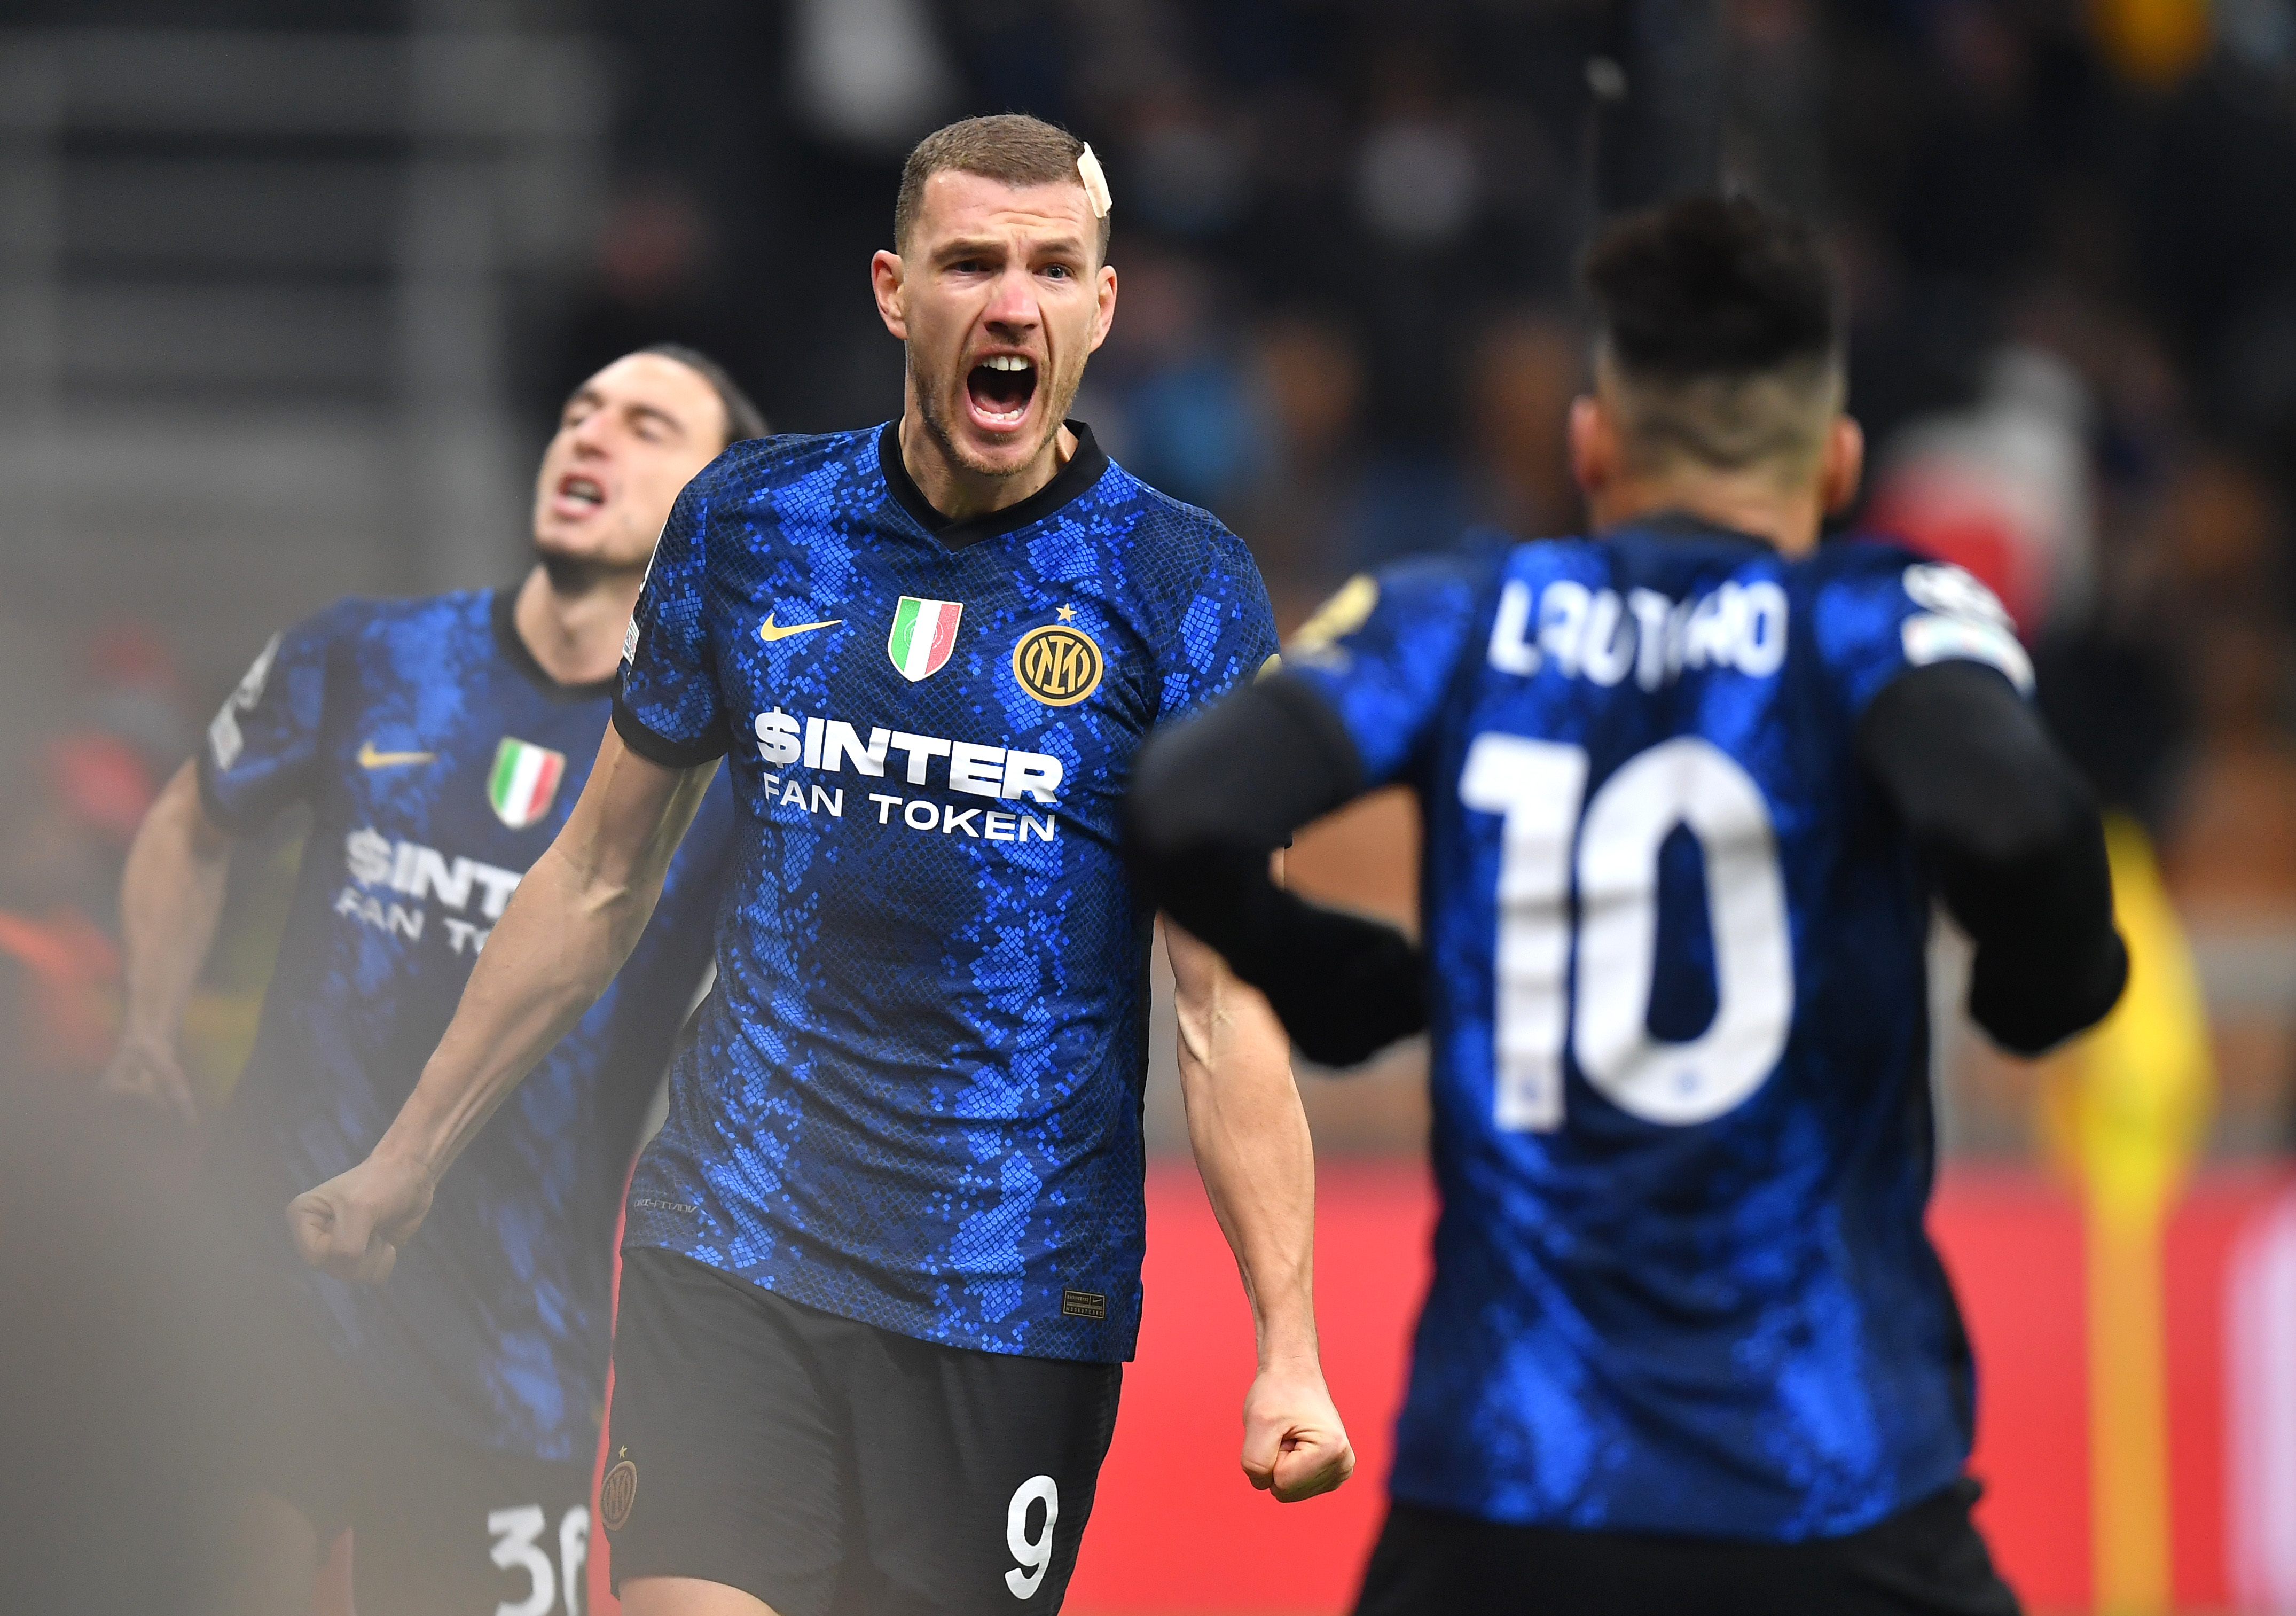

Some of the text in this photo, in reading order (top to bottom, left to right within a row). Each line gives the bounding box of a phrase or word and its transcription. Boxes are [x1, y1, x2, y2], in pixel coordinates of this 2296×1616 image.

[755, 706, 1064, 803] $INTER
[763, 772, 1055, 842] FAN TOKEN
[336, 887, 425, 941] FAN
[346, 826, 523, 920] $INT
[1459, 732, 1795, 1133] 10
[1005, 1474, 1059, 1599] 9
